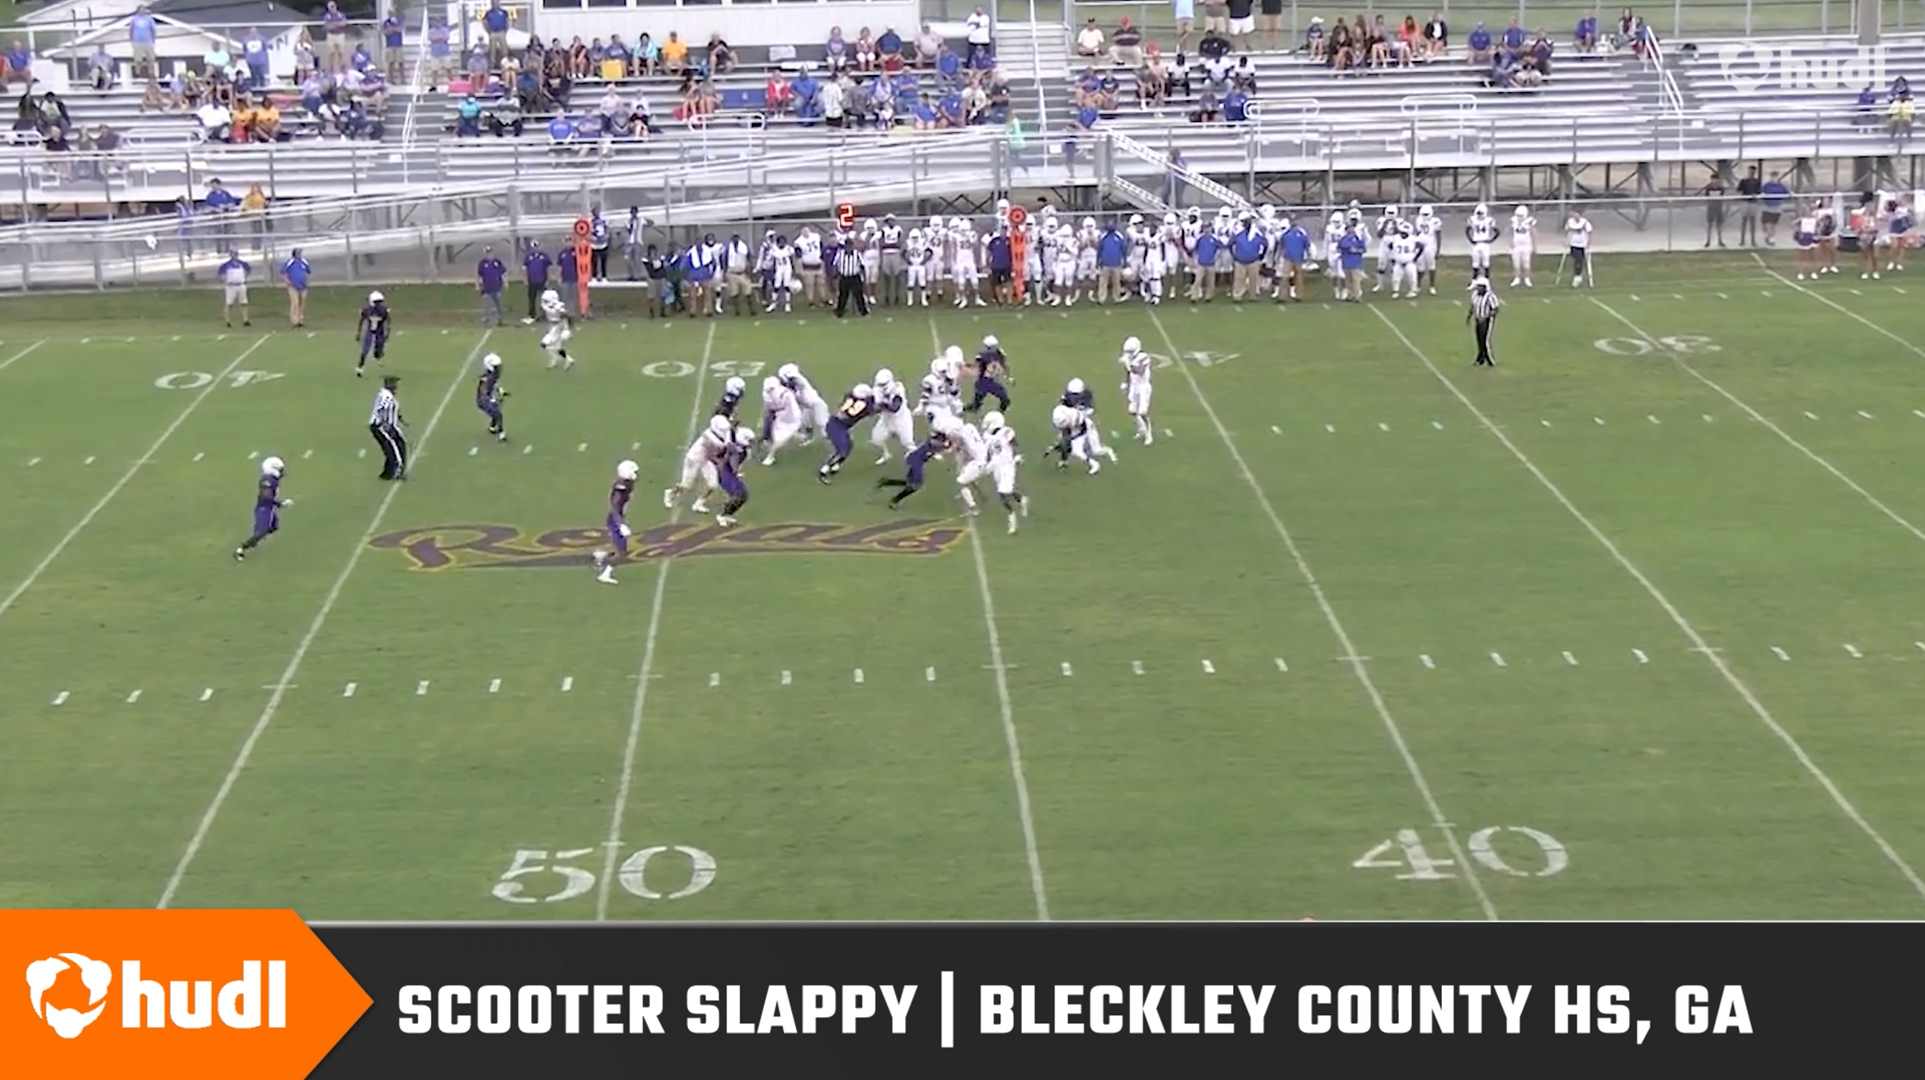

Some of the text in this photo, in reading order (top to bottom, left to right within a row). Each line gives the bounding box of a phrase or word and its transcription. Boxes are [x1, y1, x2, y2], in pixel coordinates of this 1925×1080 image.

[838, 203, 854, 227] 2
[154, 370, 286, 389] 40
[642, 361, 766, 377] 50
[368, 519, 970, 571] Royals
[1352, 825, 1568, 880] 40
[492, 845, 716, 903] 50
